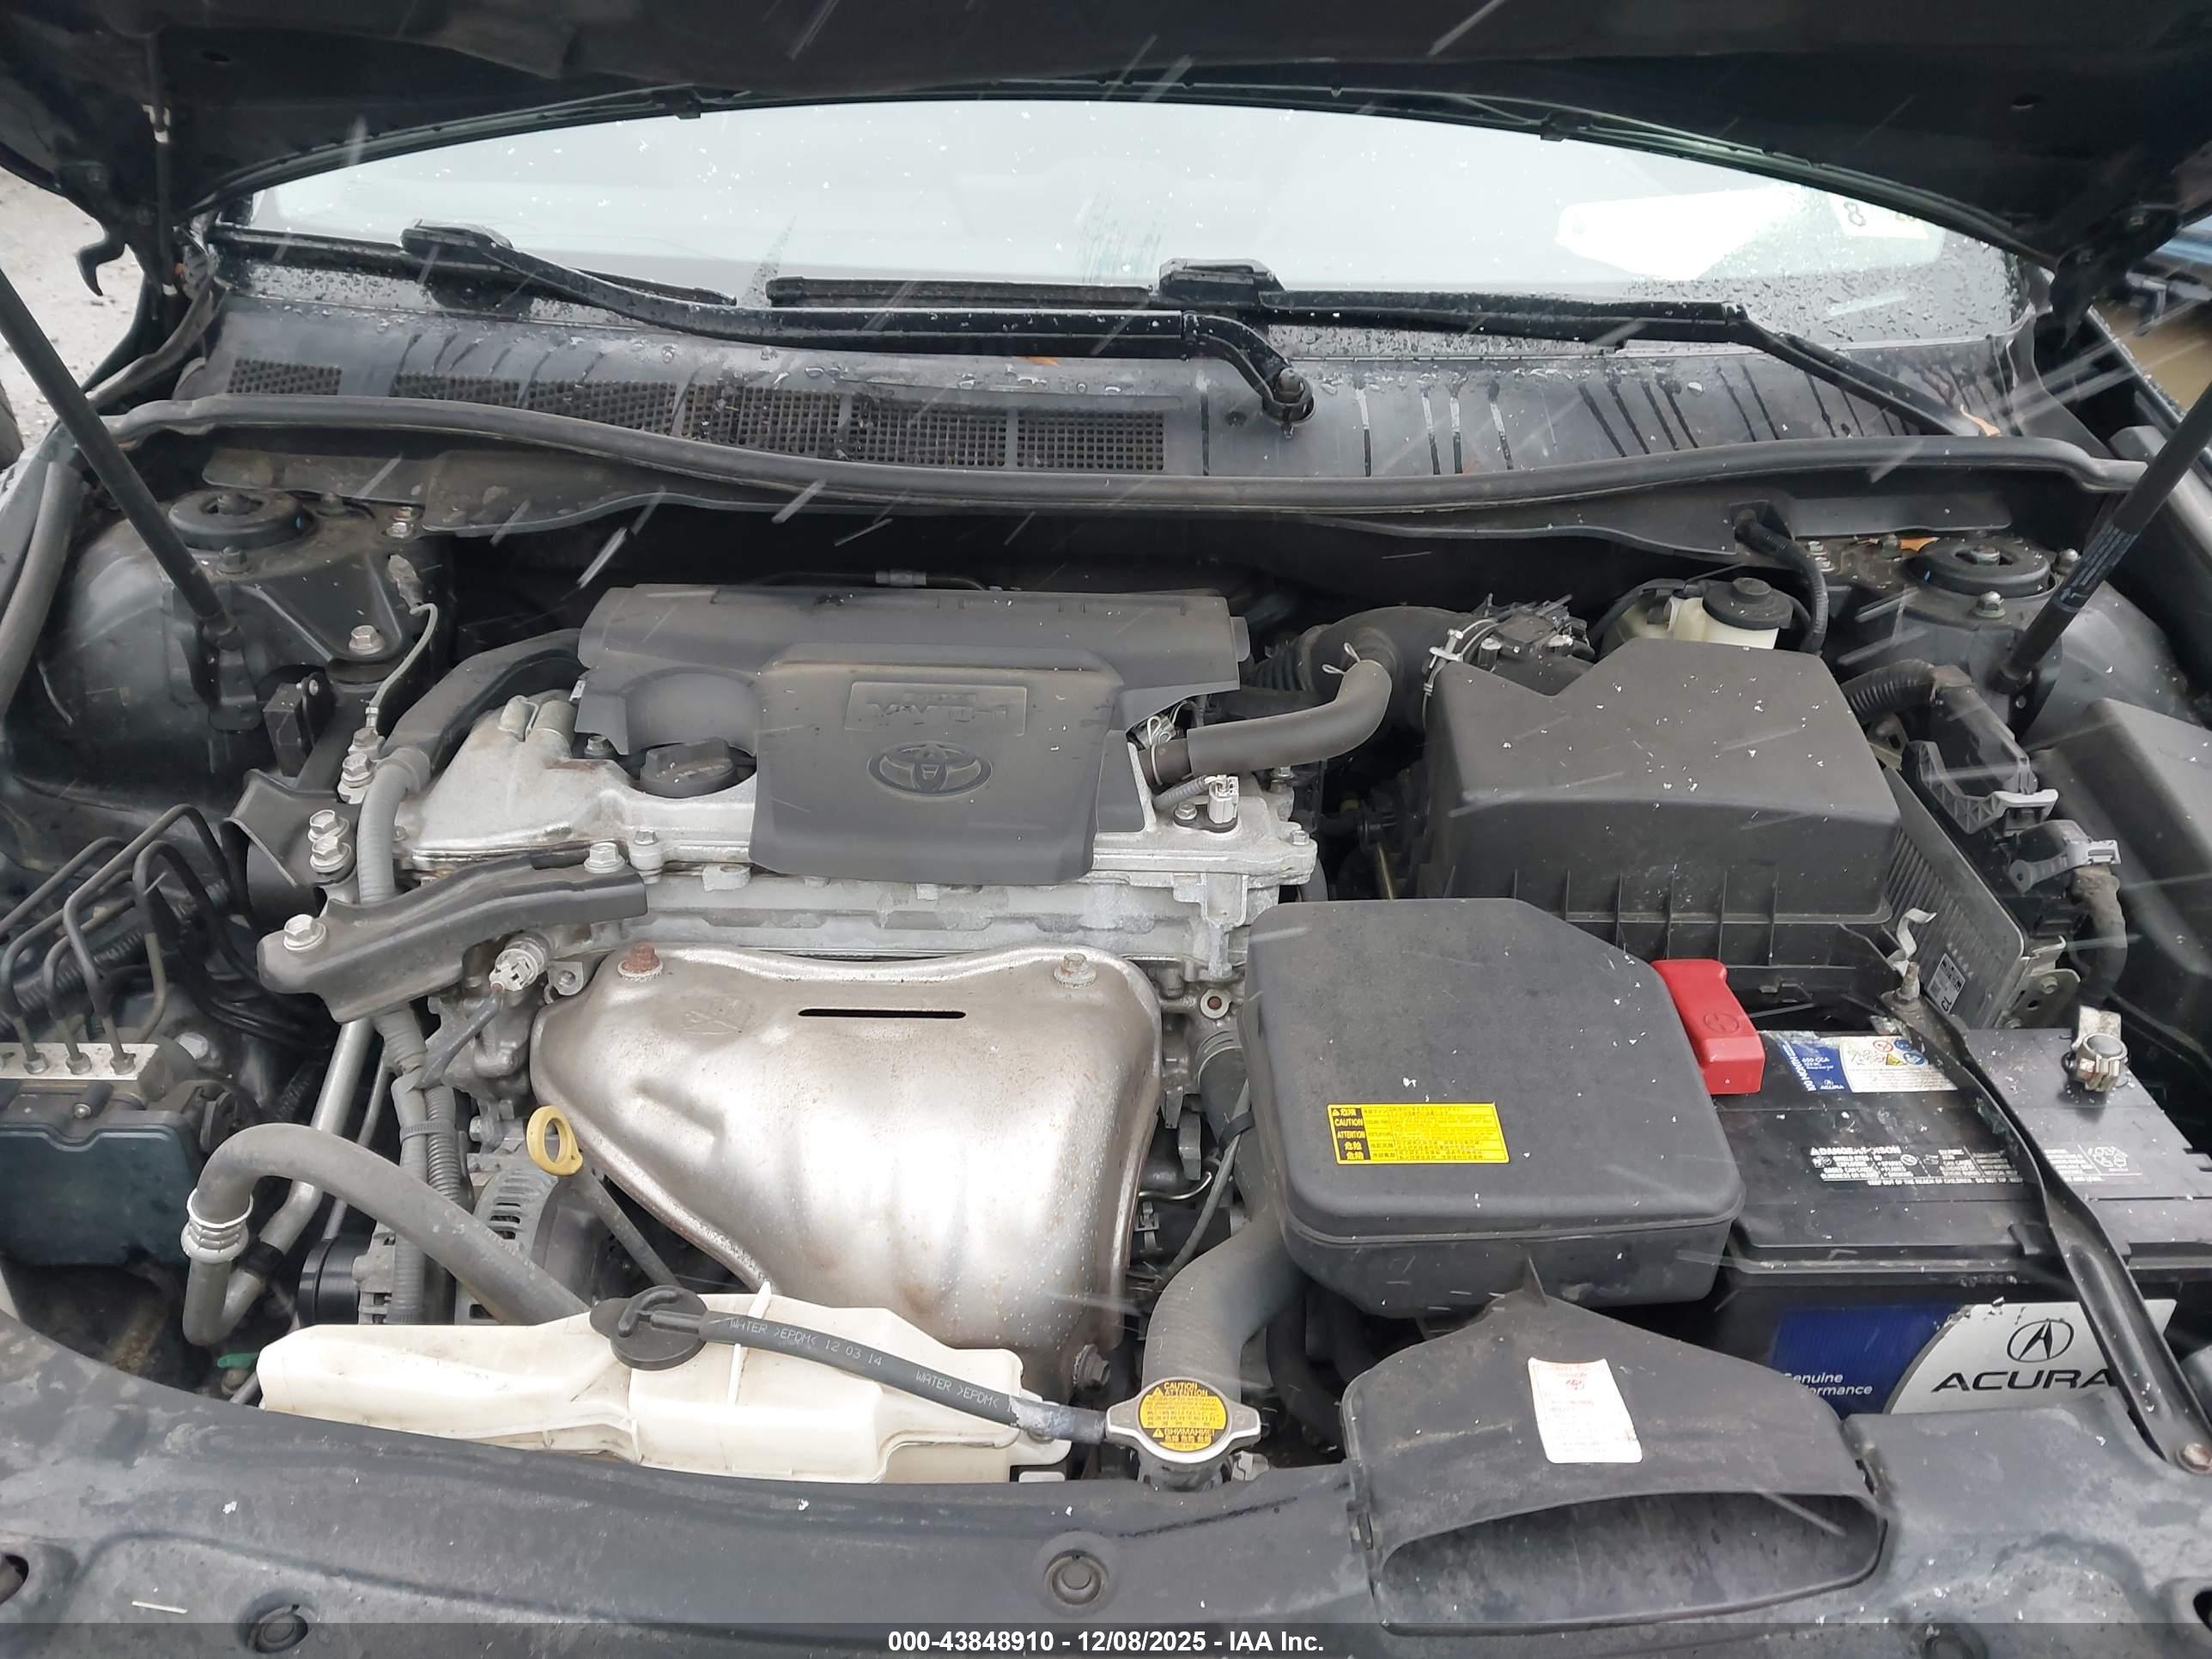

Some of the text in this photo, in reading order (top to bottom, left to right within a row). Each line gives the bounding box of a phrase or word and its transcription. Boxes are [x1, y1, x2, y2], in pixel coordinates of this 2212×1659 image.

[1334, 1118, 1364, 1127] CAUTION
[1337, 1130, 1366, 1139] ATTENTION
[730, 1318, 769, 1335] WATER
[824, 1338, 841, 1352] 12
[845, 1346, 862, 1359] 03
[867, 1353, 883, 1366] 14
[915, 1370, 952, 1392] WATER
[1930, 1369, 2116, 1392] ACURA
[1164, 1388, 1208, 1396] ATTENTION
